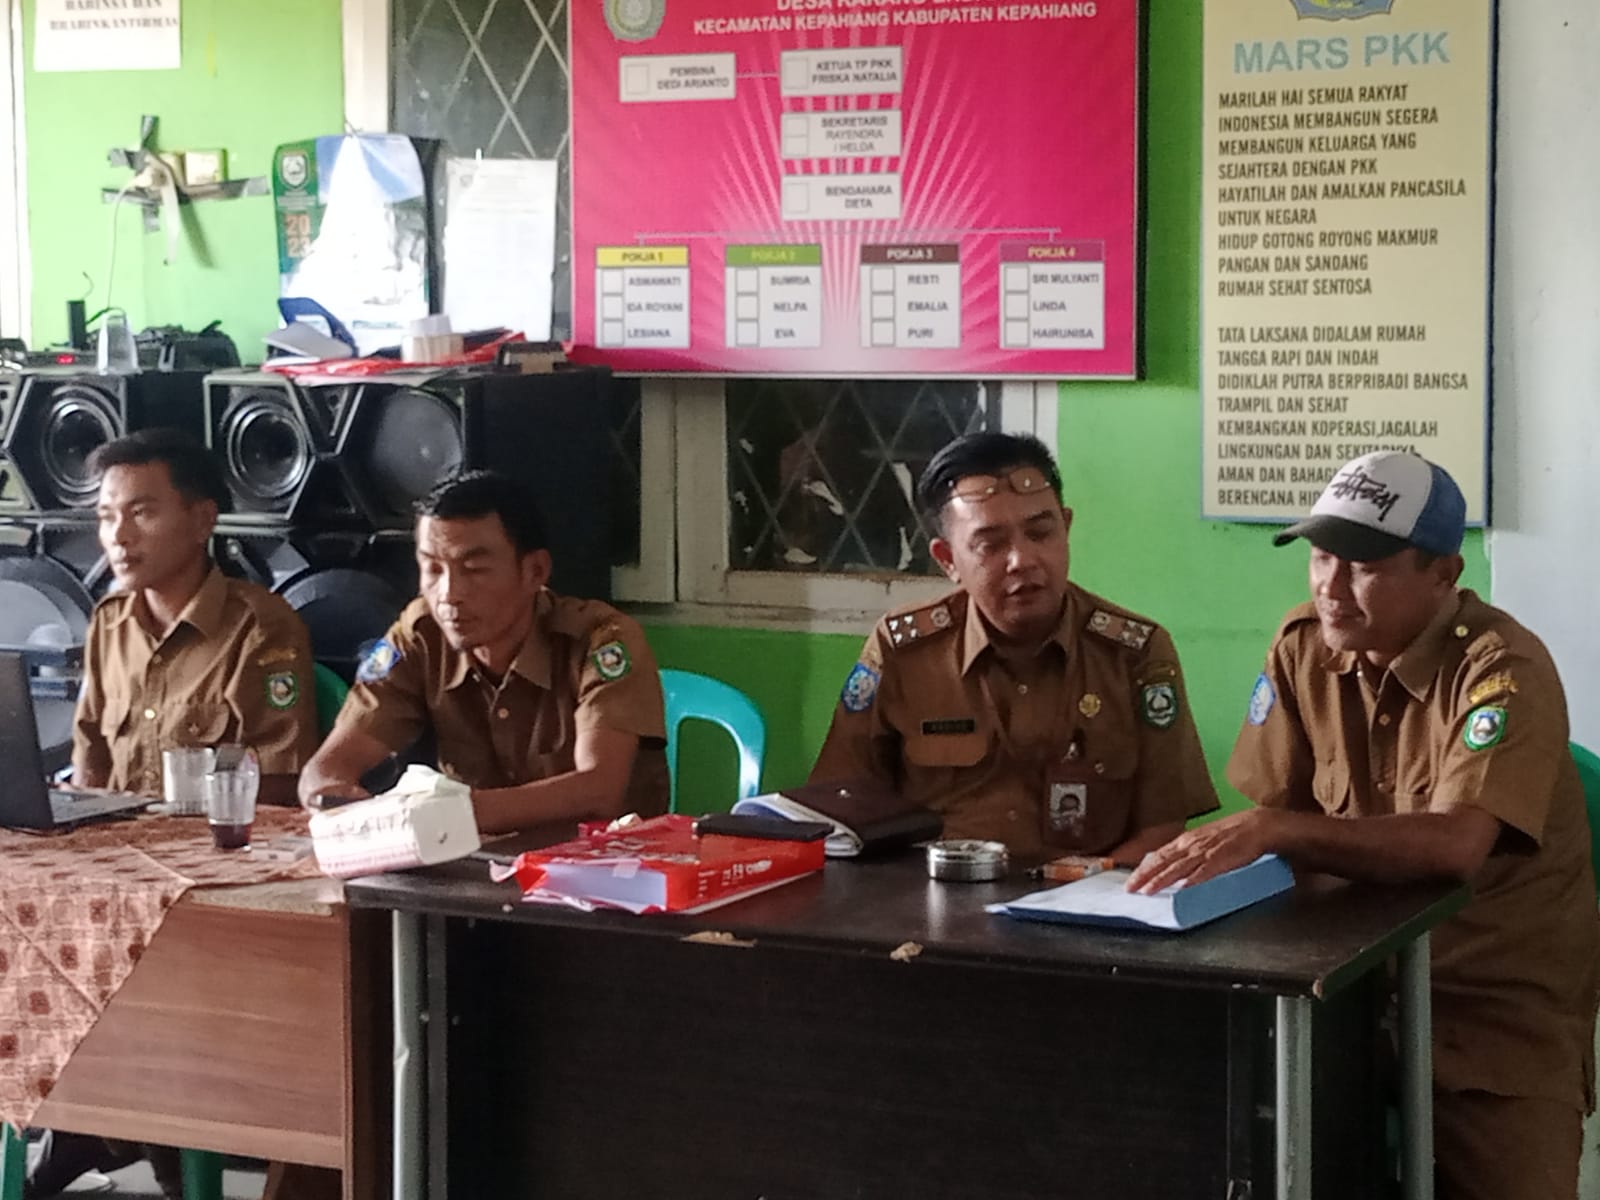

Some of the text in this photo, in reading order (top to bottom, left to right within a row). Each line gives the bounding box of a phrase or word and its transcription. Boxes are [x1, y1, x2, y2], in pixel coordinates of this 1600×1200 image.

[694, 16, 791, 35] KECAMATAN
[799, 14, 889, 30] KEPAHIANG
[893, 7, 993, 26] KABUPATEN
[998, 2, 1097, 21] KEPAHIANG
[1234, 31, 1450, 74] MARS PKK
[669, 66, 716, 77] PEMBINA
[816, 58, 894, 72] KETUA TP PKK
[657, 77, 730, 90] DEDI ARIANTO
[812, 71, 898, 84] FRISKA NATALIA
[1219, 85, 1408, 109] MARILAH HAI SEMUA RAKYAT
[821, 115, 888, 128] SEKRETARIS
[1219, 108, 1438, 132] INDONESIA MEMBANGUN SEGERA
[1219, 133, 1416, 156] MEMBANGUN KELUARGA YANG
[1219, 158, 1377, 179] SEJAHTERA DENGAN PKK
[825, 184, 893, 197] BENDAHARA
[1219, 179, 1466, 203] HAYATILAH DAN AMALKAN PANCASILA
[844, 197, 873, 209] DETA
[284, 213, 311, 236] 20
[1219, 209, 1317, 227] UNTUK NEGARA
[1219, 229, 1438, 250] HIDUP GOTONG ROYONG MAKMUR
[621, 252, 656, 262] POKJA
[886, 248, 924, 260] POKJA
[1027, 247, 1066, 258] POKJA
[1219, 254, 1368, 273] PANGAN DAN SANDANG
[907, 274, 940, 285] RESTI
[1032, 273, 1099, 284] SRI MULYANTI
[1219, 278, 1372, 296] RUMAH SEHAT SENTOSA
[627, 302, 684, 312] IDA ROYANI
[907, 301, 948, 312] EMALIA
[1032, 301, 1067, 312] LINDA
[774, 328, 796, 339] EVA
[907, 328, 933, 339] PURI
[1032, 328, 1094, 339] HAIRUNISA
[1218, 325, 1426, 343] TATA LAKSANA DIDALAM RUMAH
[1218, 349, 1378, 366] TANGGA RAPI DAN INDAH
[1218, 373, 1468, 389] DIDIKLAH PUTRA BERPRIBADI BANGSA
[1218, 397, 1349, 413] TRAMPIL DAN SEHAT
[1218, 420, 1438, 438] KEMBANGKAN KOPERASI,JAGALAH
[1218, 444, 1298, 460] LINGKUNGAN
[1305, 444, 1331, 459] DAN
[1218, 467, 1337, 482] AMAN DAN BAHAG
[1218, 490, 1294, 506] BERENCANA
